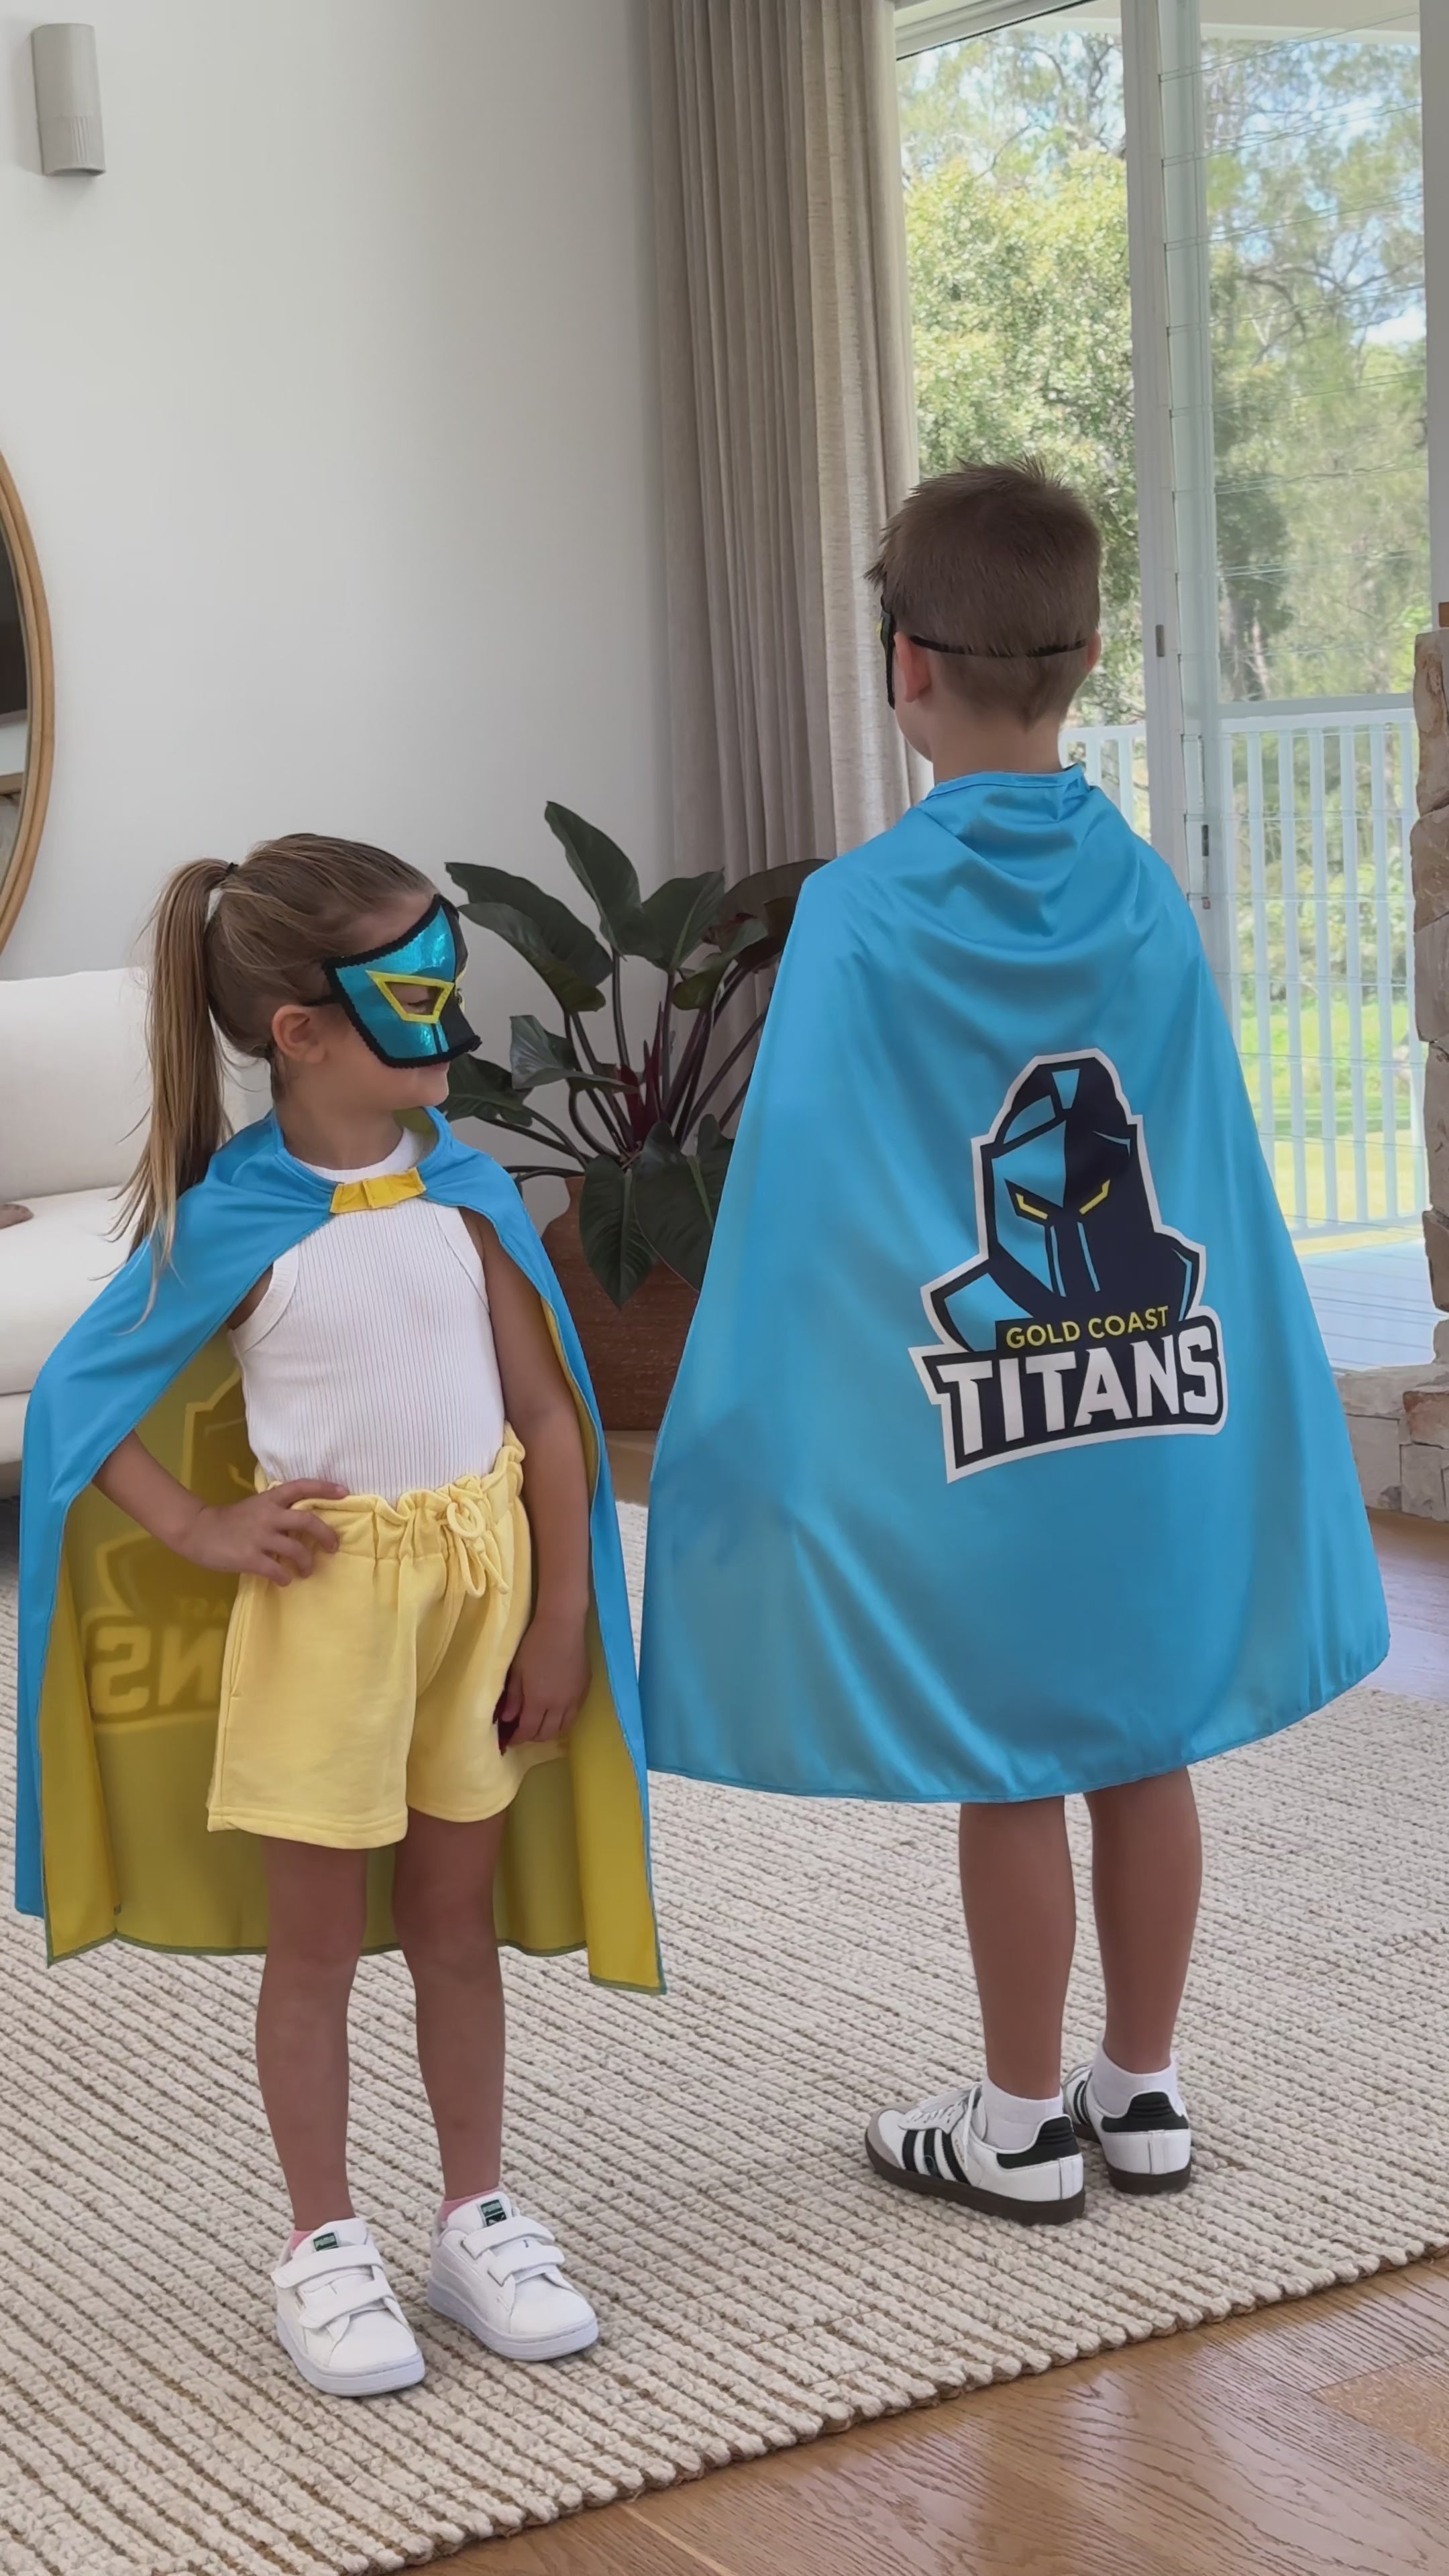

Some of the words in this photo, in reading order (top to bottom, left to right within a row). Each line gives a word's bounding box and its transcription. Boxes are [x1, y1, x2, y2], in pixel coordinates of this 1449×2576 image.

[1006, 1321, 1081, 1349] GOLD
[1088, 1305, 1169, 1339] COAST
[936, 1325, 1219, 1456] TITANS
